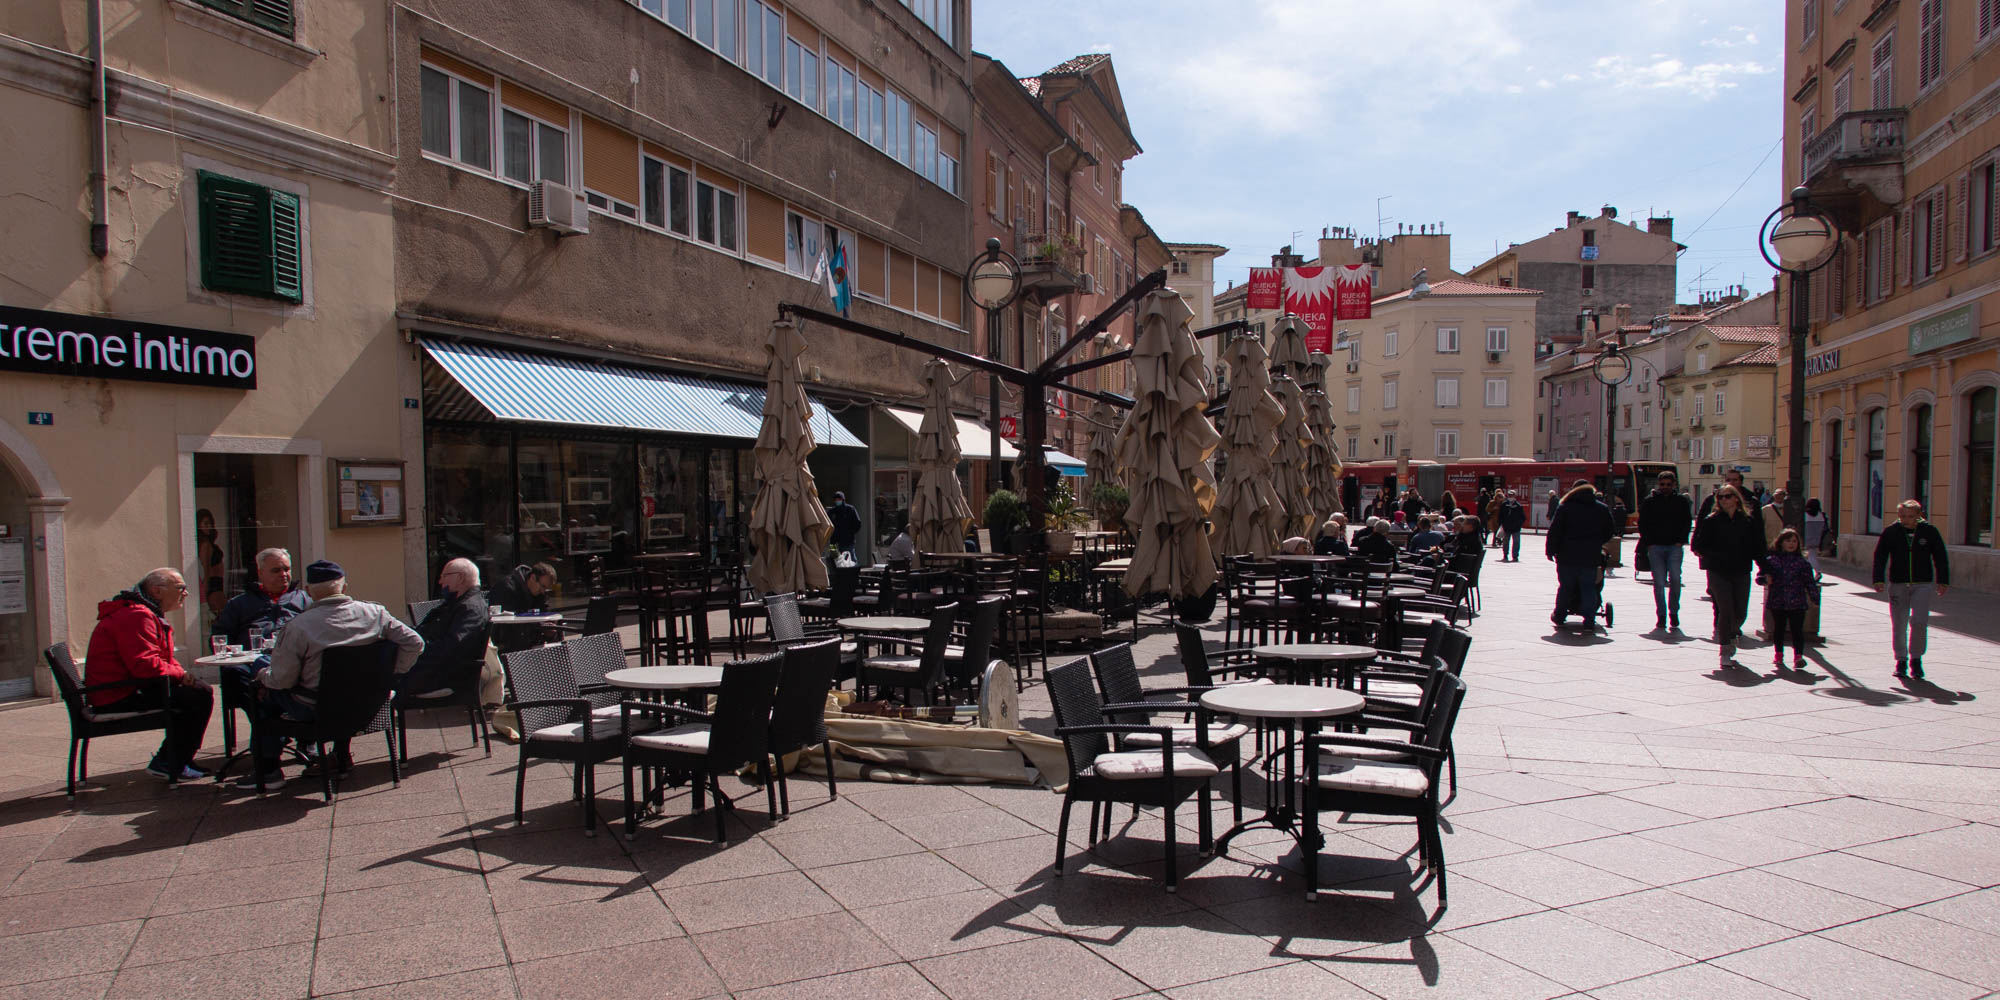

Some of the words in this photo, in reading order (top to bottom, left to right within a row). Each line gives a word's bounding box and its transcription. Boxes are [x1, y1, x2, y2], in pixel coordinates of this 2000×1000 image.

[1922, 323, 1940, 338] YVES
[1940, 312, 1970, 333] ROCHER
[133, 331, 254, 378] intimo
[1805, 349, 1840, 377] AROVSKI
